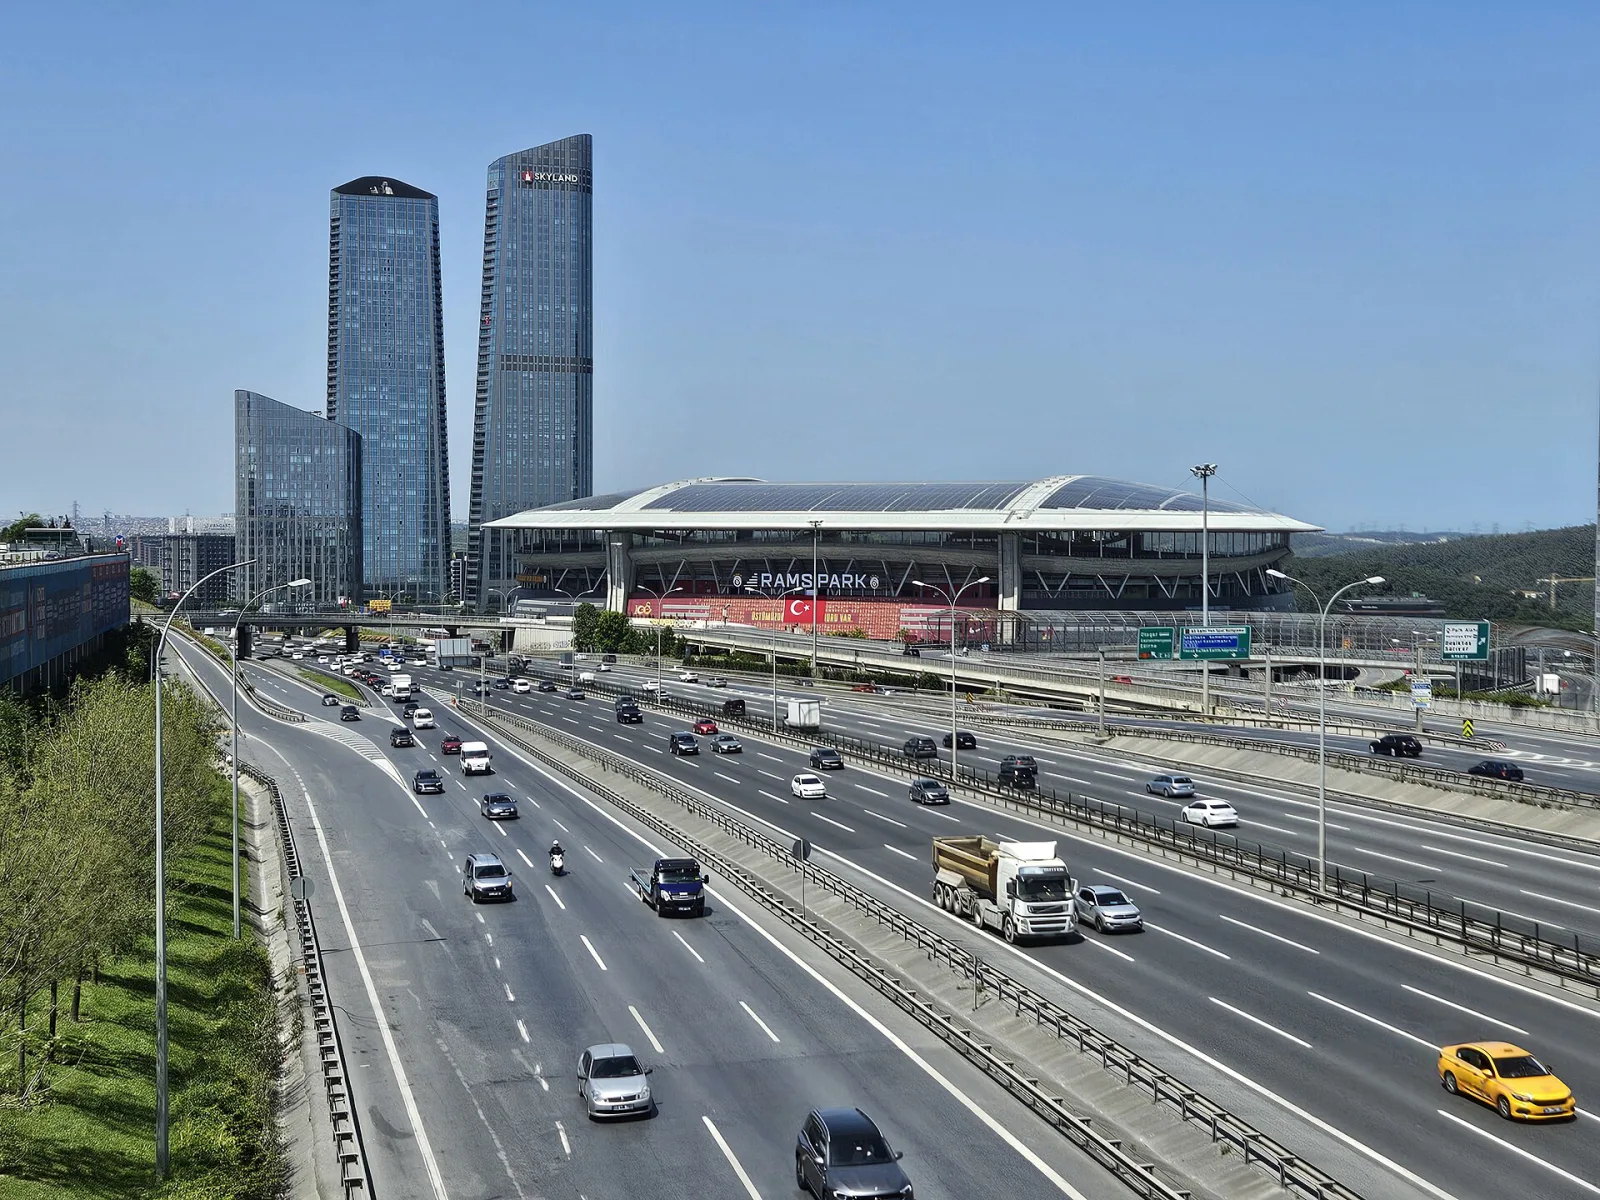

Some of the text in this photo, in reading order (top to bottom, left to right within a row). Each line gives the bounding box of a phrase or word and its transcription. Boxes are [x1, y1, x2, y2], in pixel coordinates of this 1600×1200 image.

[534, 172, 578, 182] SKYLAND
[761, 573, 867, 588] RAMS PARK
